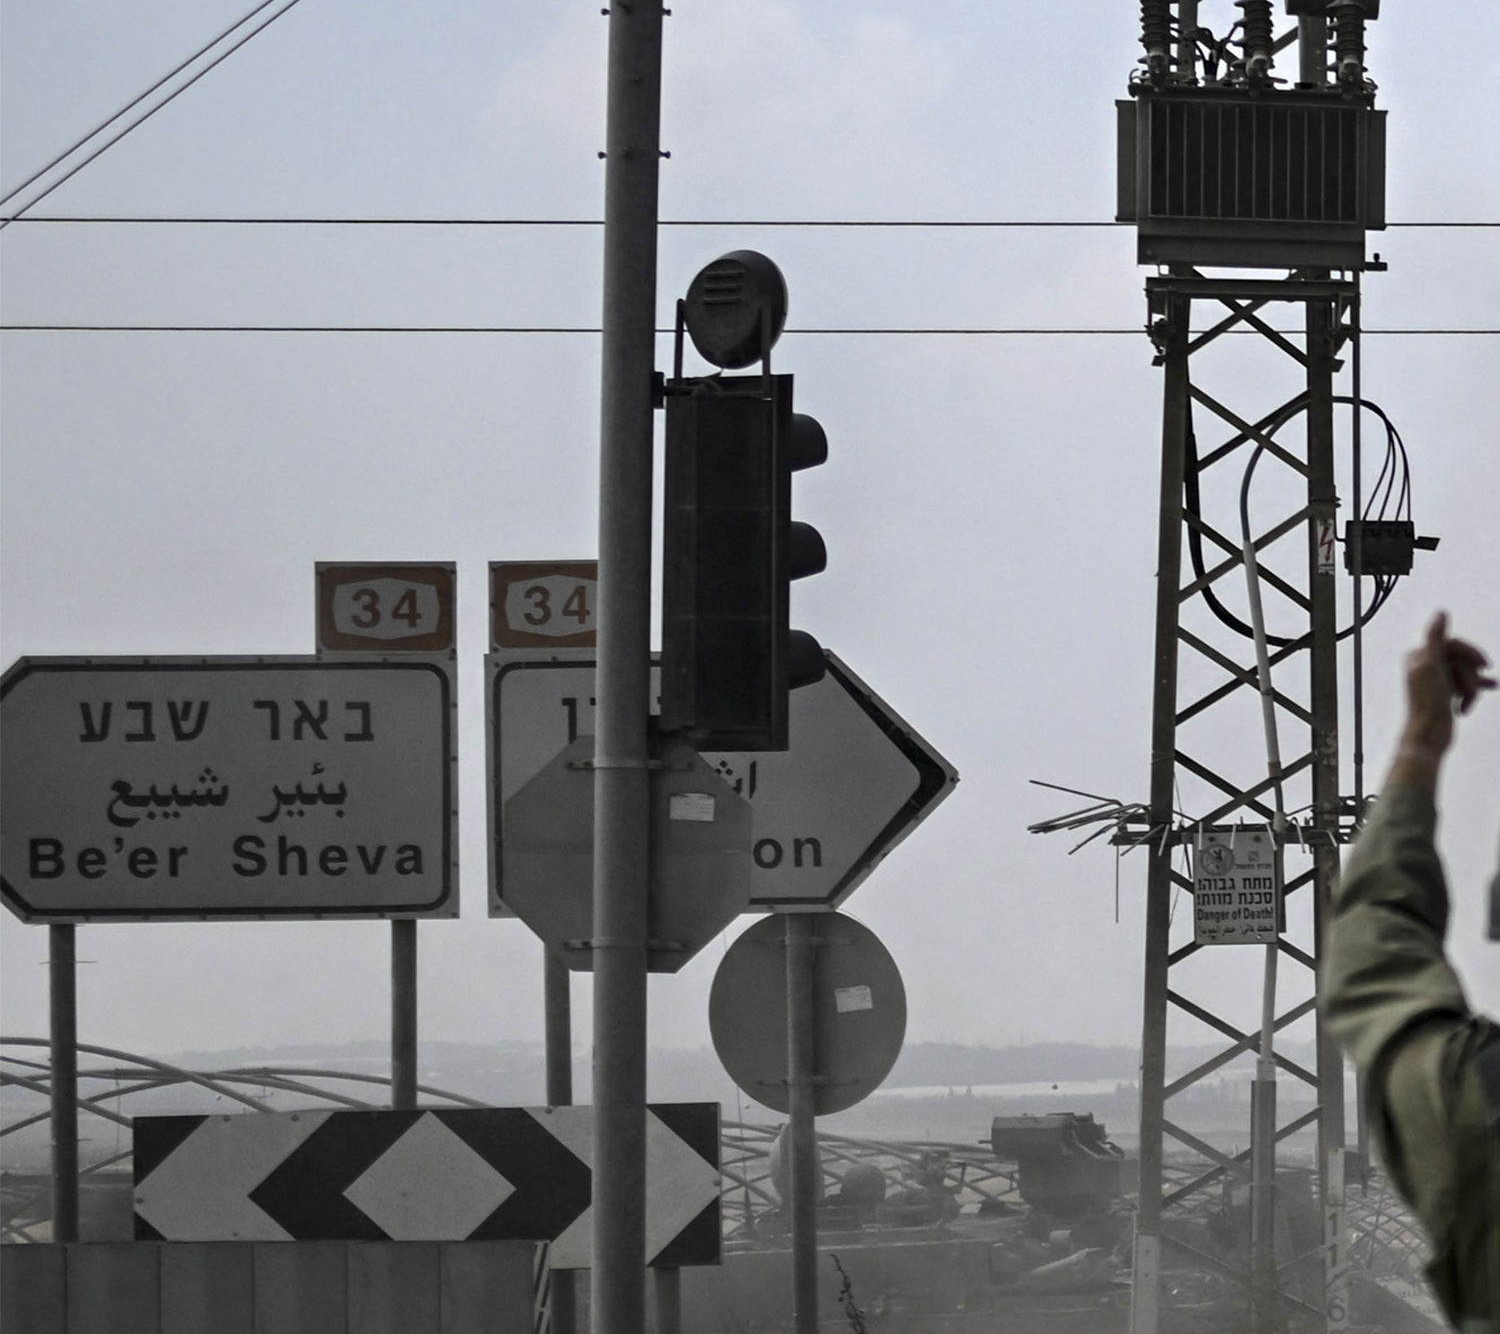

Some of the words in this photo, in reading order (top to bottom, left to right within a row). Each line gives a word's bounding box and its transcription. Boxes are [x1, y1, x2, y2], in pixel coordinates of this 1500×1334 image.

[351, 588, 423, 629] 34
[523, 585, 592, 626] 34
[79, 700, 210, 743] שבע
[252, 698, 375, 742] באר
[256, 760, 349, 823] بئير
[28, 837, 188, 880] Be'er
[231, 834, 425, 878] Sheva
[1238, 891, 1273, 905] סכנת
[1242, 877, 1272, 890] מתח
[1197, 908, 1230, 923] Danger
[1231, 907, 1242, 920] of
